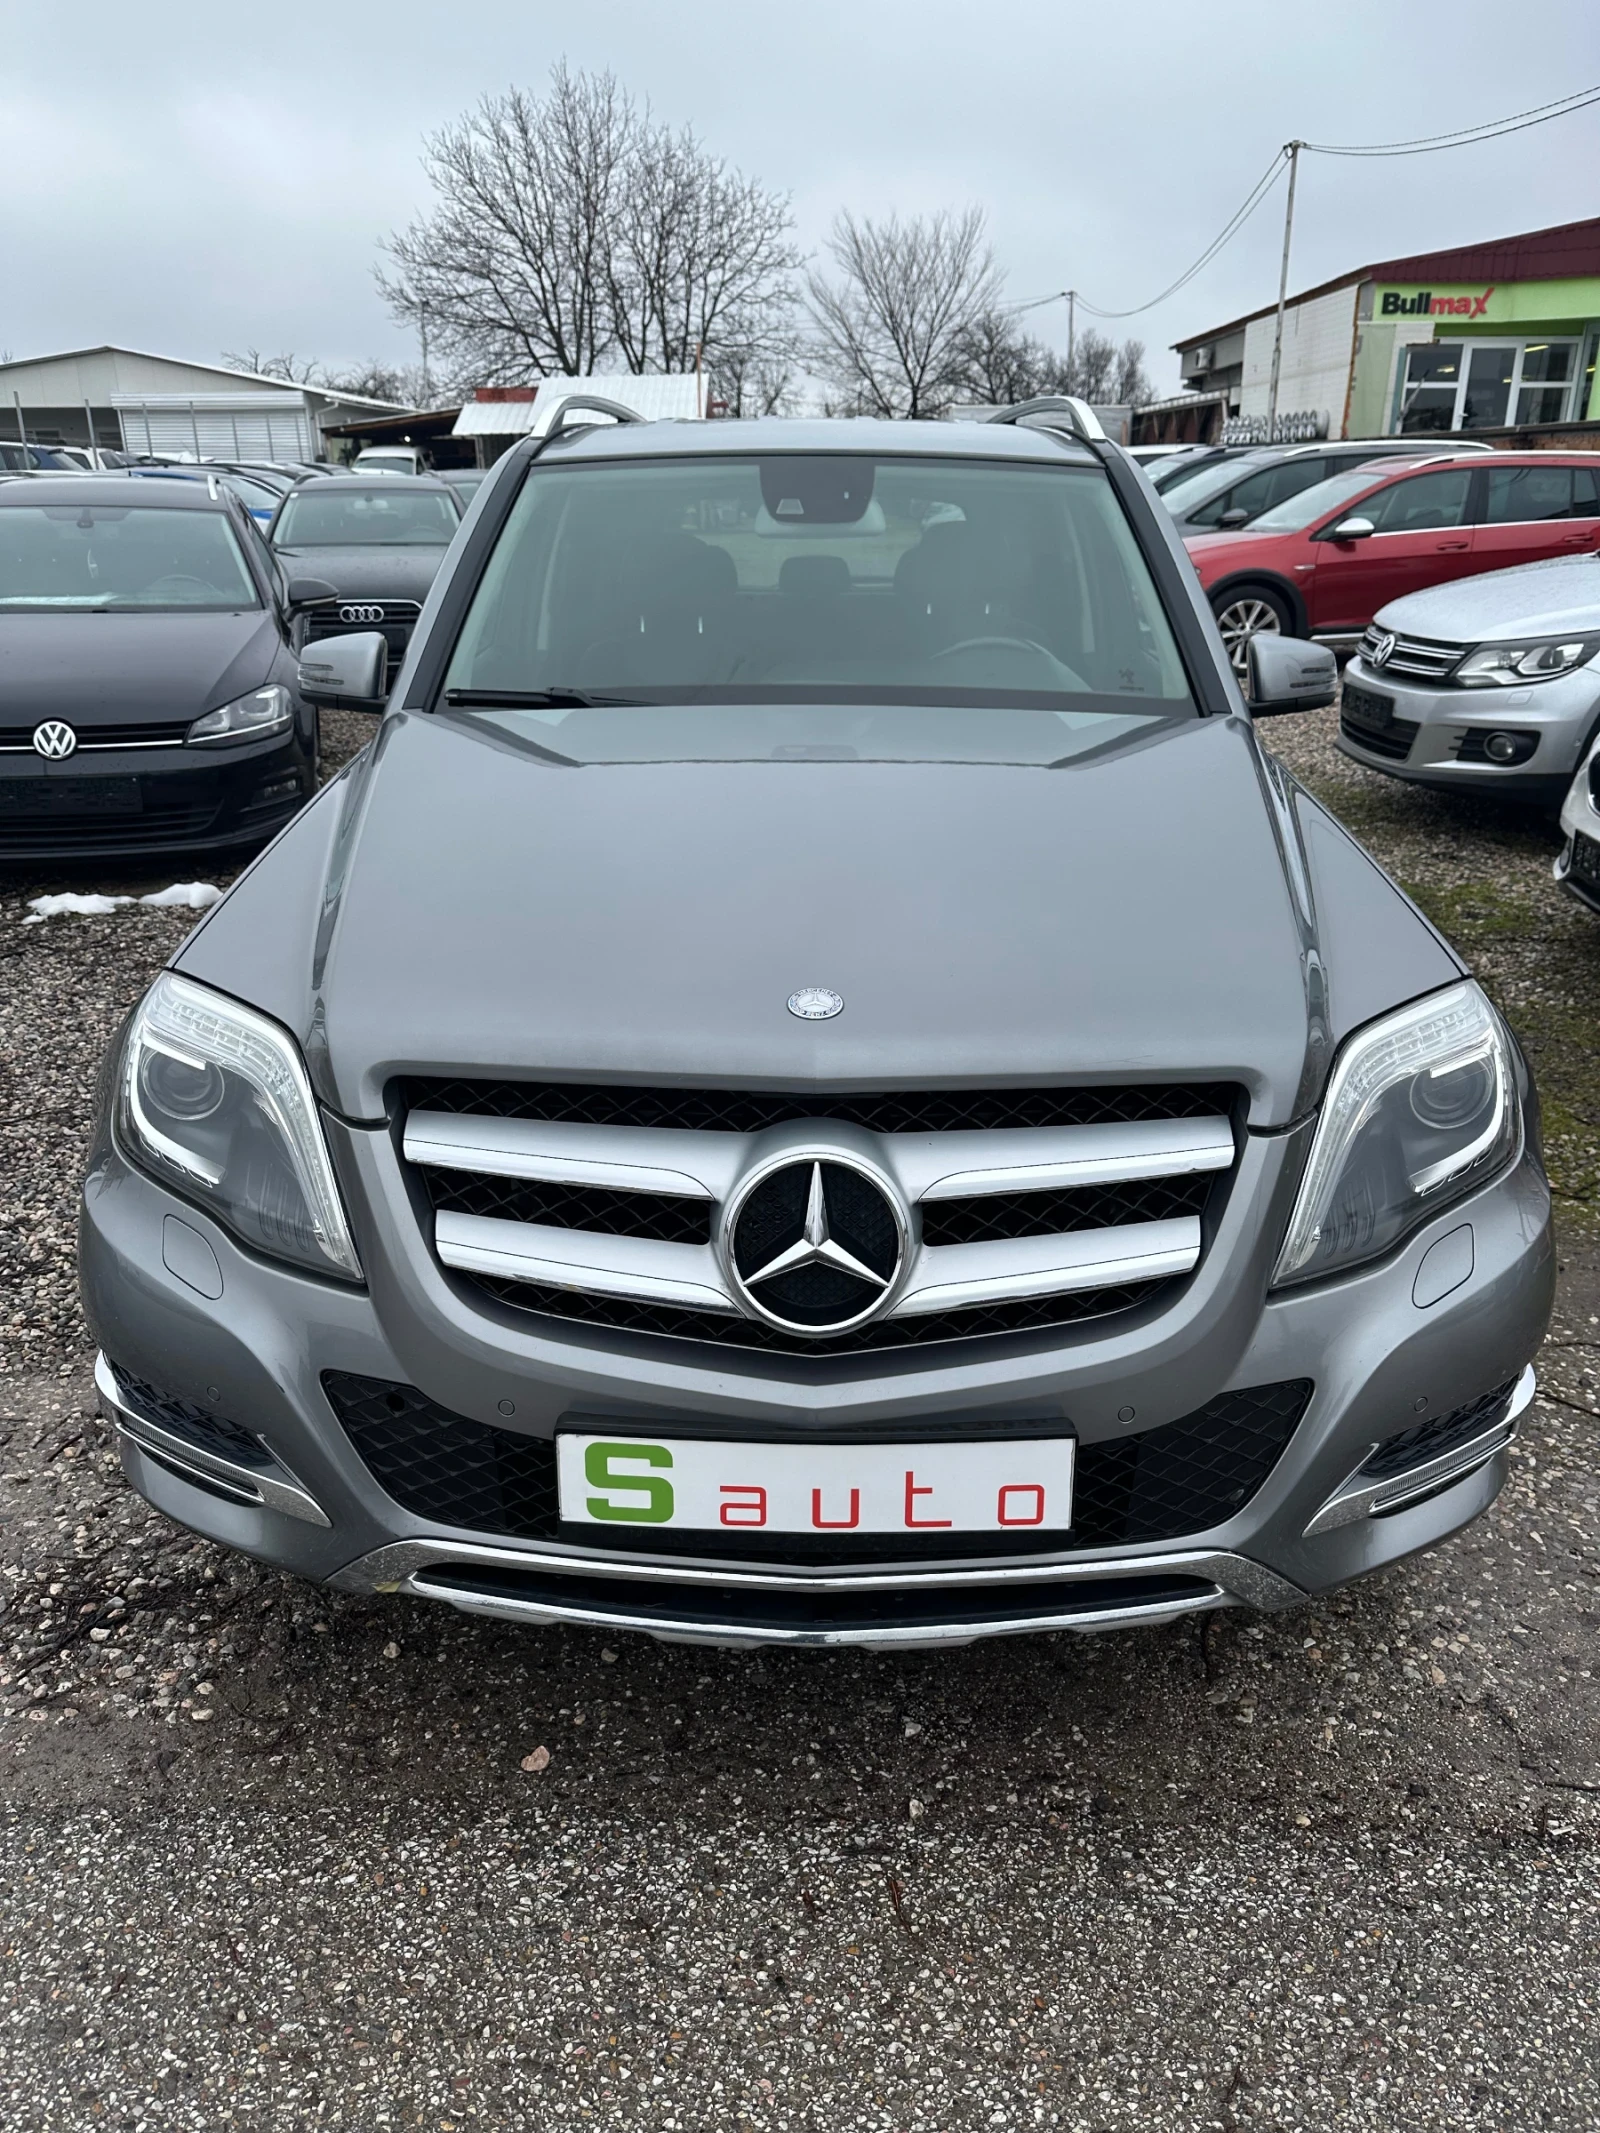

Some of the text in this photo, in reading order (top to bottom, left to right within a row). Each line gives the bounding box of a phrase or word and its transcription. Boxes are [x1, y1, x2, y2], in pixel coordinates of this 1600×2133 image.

[1381, 286, 1495, 319] Bullmax
[584, 1441, 1046, 1529] S auto
